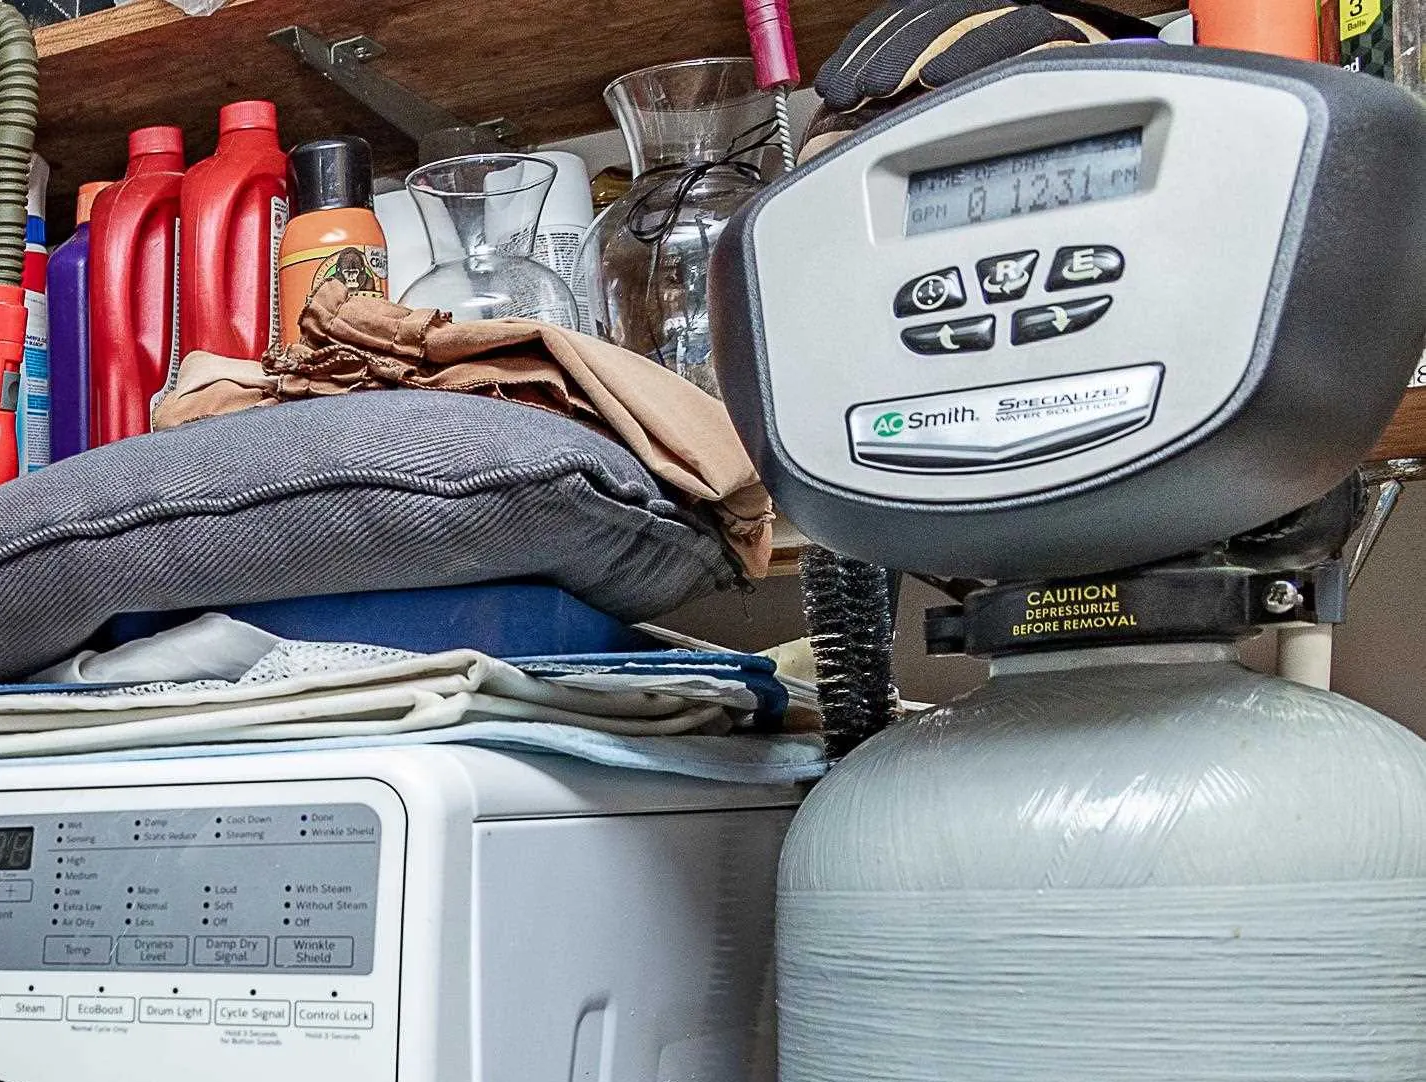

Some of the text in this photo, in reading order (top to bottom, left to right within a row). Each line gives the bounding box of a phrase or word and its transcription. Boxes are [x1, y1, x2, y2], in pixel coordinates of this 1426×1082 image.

[1349, 0, 1363, 17] 3
[1347, 20, 1367, 31] Balls
[916, 174, 965, 193] TIME
[912, 204, 948, 224] GPM
[1110, 165, 1141, 187] PM
[1073, 248, 1095, 272] E
[998, 385, 1130, 409] SPECIALIZED
[995, 400, 1128, 423] WATER SOLUTIONS
[874, 413, 904, 436] AO
[1027, 584, 1117, 606] CAUTION
[1025, 601, 1120, 620] DEPRESSURIZE
[1012, 614, 1137, 636] BEFORE REMOVAL
[248, 815, 272, 824] Down
[311, 827, 374, 837] Wrinkle Shield
[65, 871, 98, 880] Medium
[64, 887, 80, 896] Low
[215, 886, 238, 894] Loud
[296, 884, 352, 893] With Steam
[63, 903, 102, 911] Extra Low
[215, 902, 234, 910] Soft
[296, 901, 368, 910] Without Steam
[213, 918, 228, 926] Off
[294, 918, 310, 927] Off
[65, 944, 91, 957] Temp
[134, 940, 173, 952] Dryness
[206, 939, 258, 951] Damp Dry
[293, 940, 336, 950] Wrinkle
[140, 952, 166, 961] Level
[215, 951, 247, 963] Signal
[296, 953, 331, 964] Shield
[15, 1003, 45, 1013] Steam
[78, 1004, 123, 1014] EcoBoost
[147, 1006, 203, 1018] Drum Light
[221, 1008, 285, 1021] Cycle Signal
[299, 1009, 368, 1021] Control Lock
